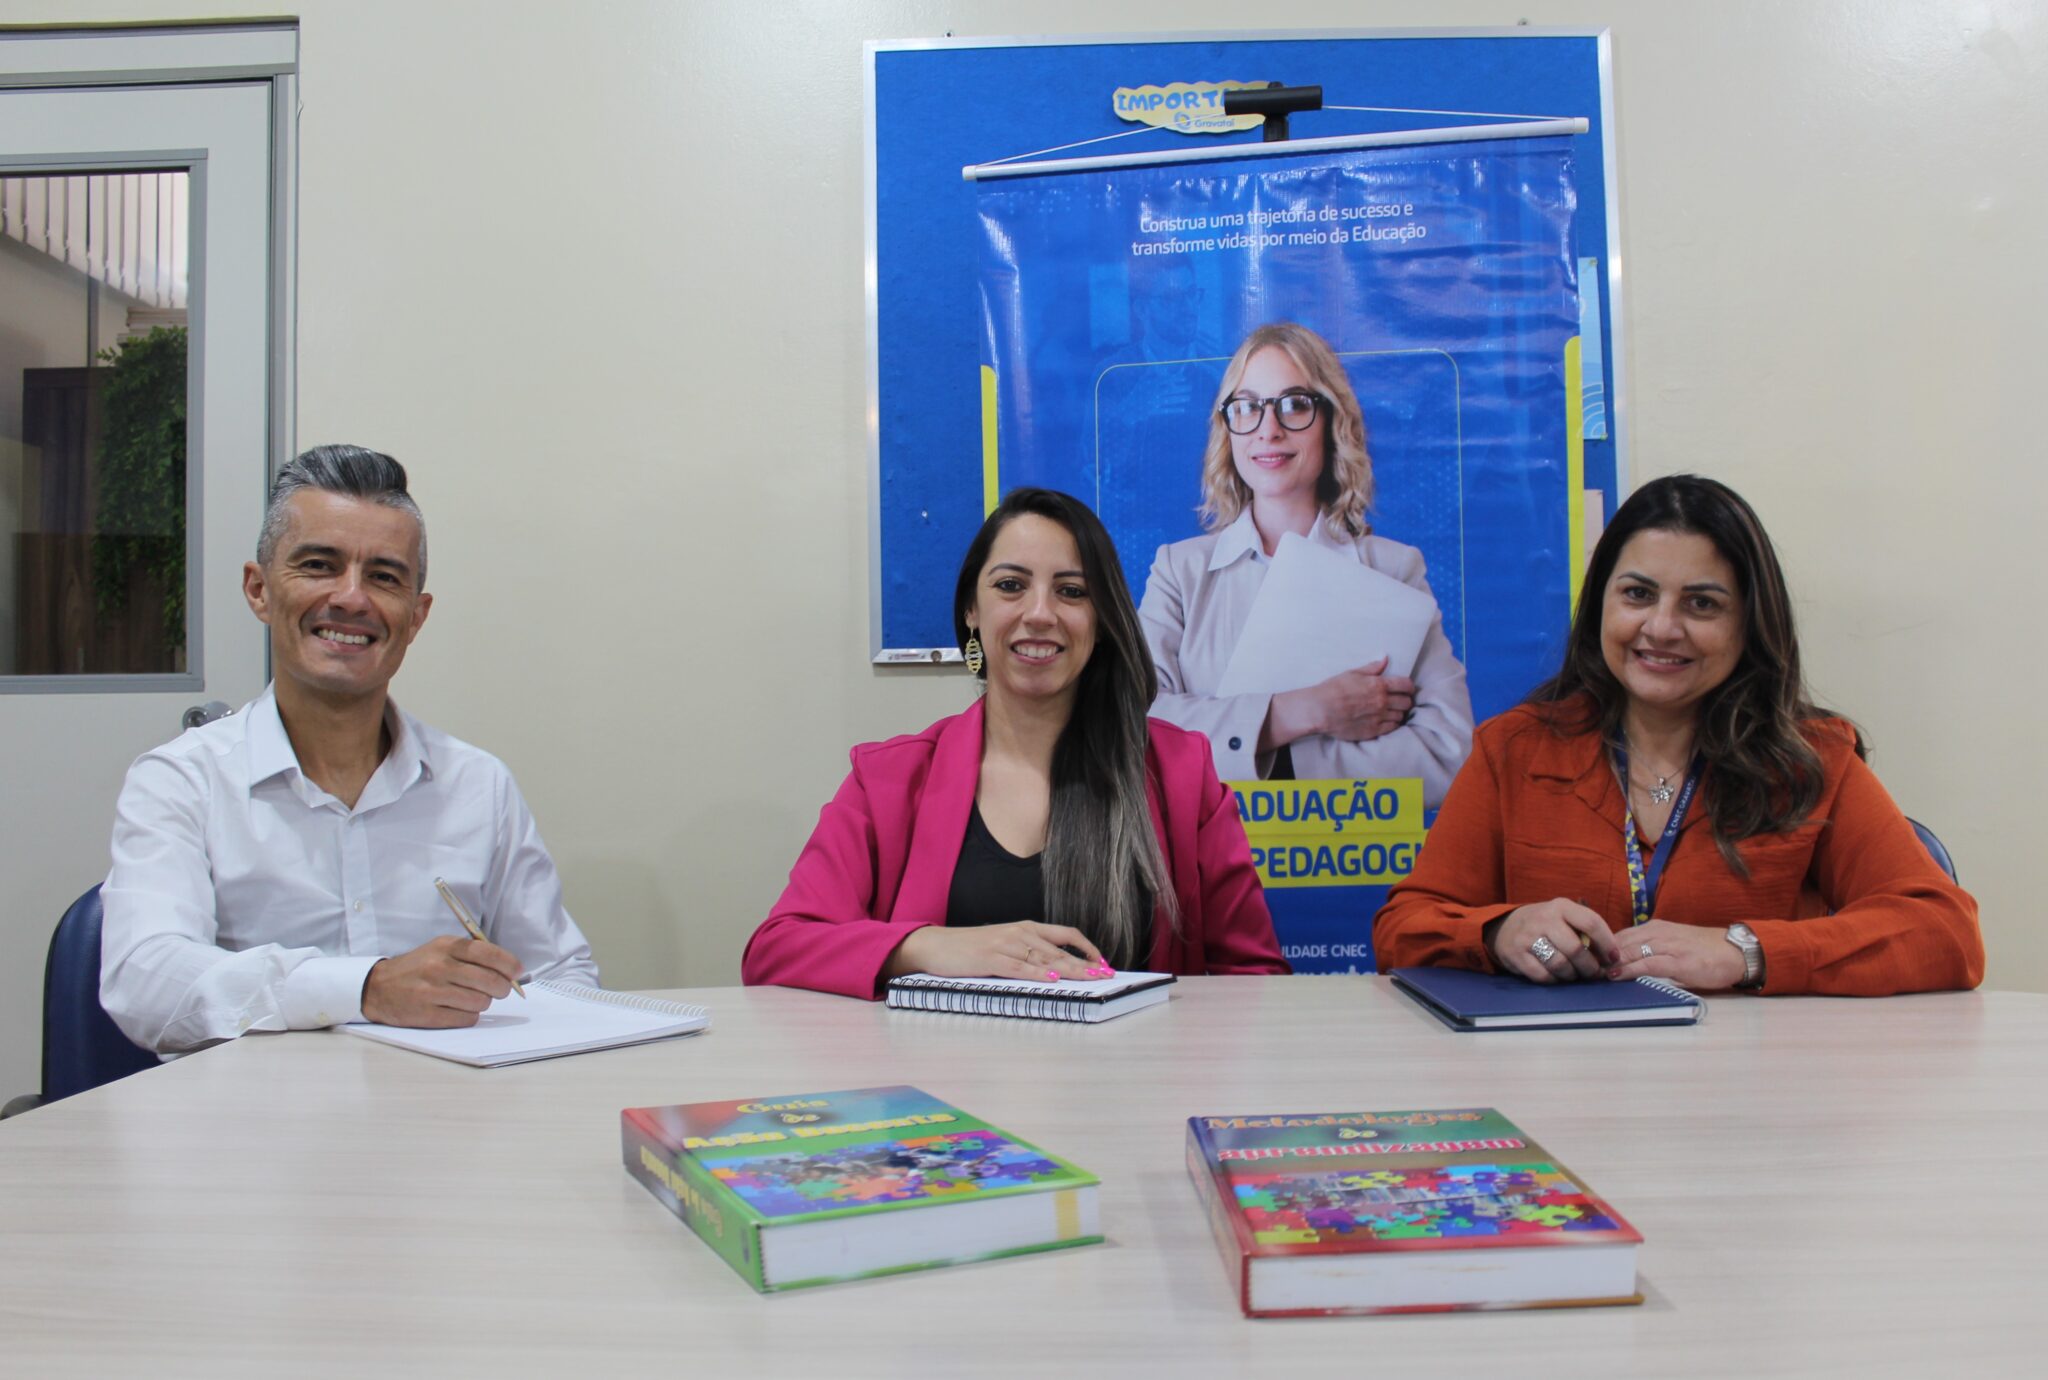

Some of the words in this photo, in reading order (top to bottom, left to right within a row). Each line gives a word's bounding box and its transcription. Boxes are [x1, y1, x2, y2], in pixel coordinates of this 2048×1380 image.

[1117, 88, 1226, 112] IMPORT
[1140, 216, 1207, 233] Construa
[1210, 213, 1244, 228] uma
[1247, 206, 1316, 228] trajetória
[1319, 205, 1338, 221] de
[1341, 204, 1401, 220] sucesso
[1404, 203, 1414, 216] e
[1131, 237, 1215, 256] transforme
[1217, 232, 1257, 249] vidas
[1260, 233, 1285, 251] por
[1288, 229, 1327, 245] meio
[1329, 227, 1349, 243] da
[1352, 222, 1427, 244] Educação
[1330, 944, 1367, 958] CNEC
[1218, 1139, 1524, 1160] aprendizagem
